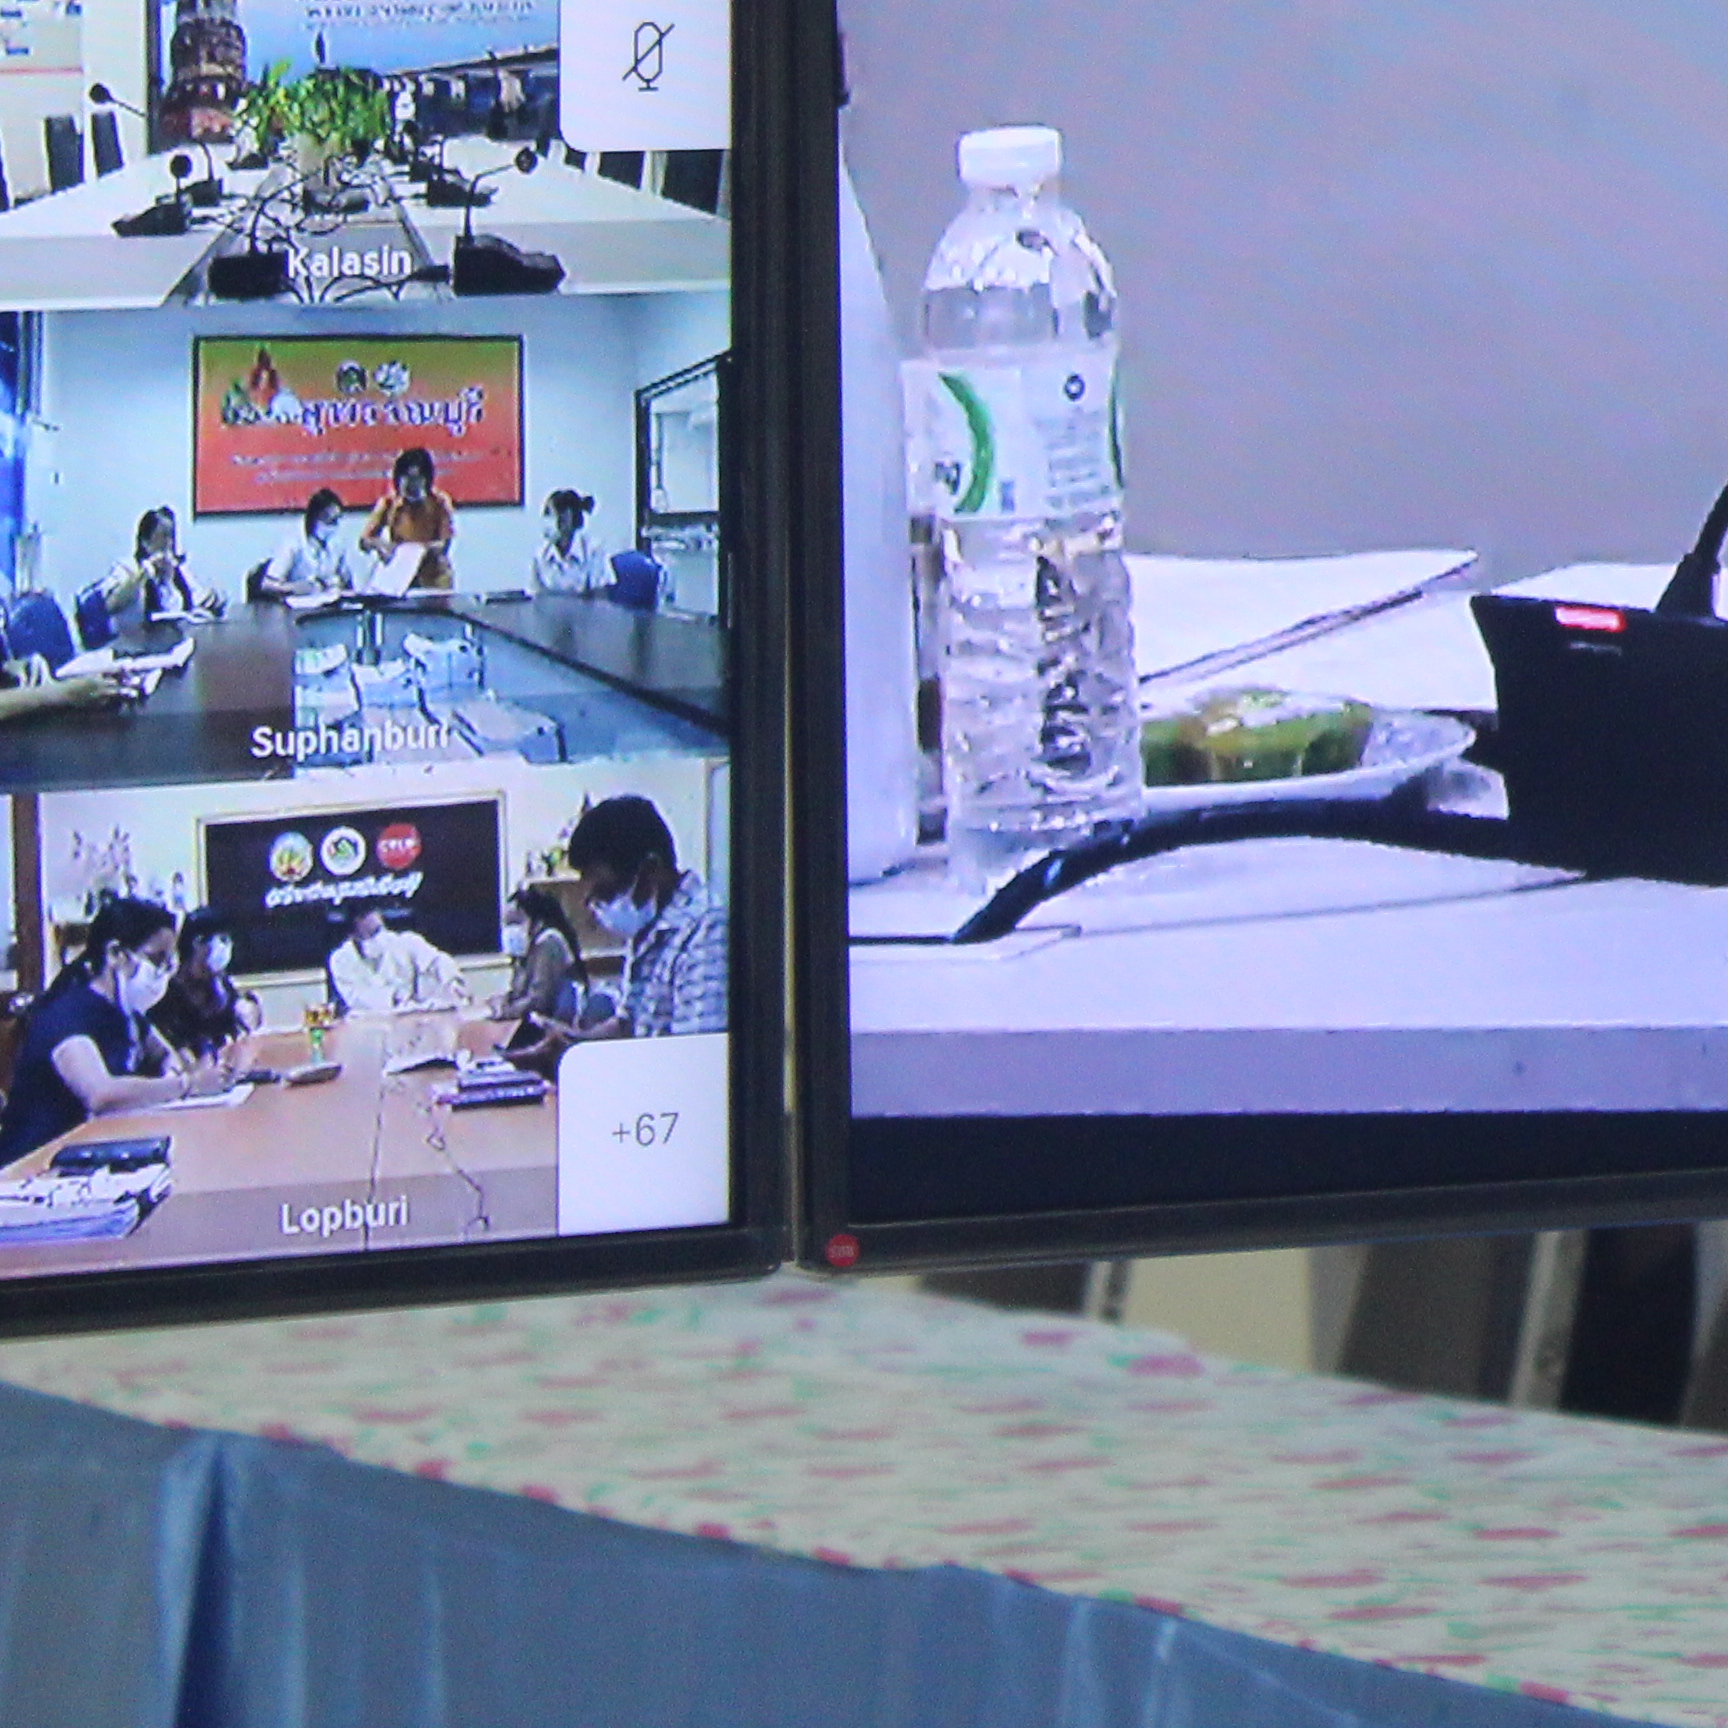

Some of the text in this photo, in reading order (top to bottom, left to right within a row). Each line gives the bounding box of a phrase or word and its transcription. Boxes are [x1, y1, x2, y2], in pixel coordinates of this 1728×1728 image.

[287, 243, 413, 279] Kalasin
[250, 718, 449, 763] Suphanburi
[611, 1112, 679, 1147] +67
[281, 1194, 409, 1239] Lopburi
